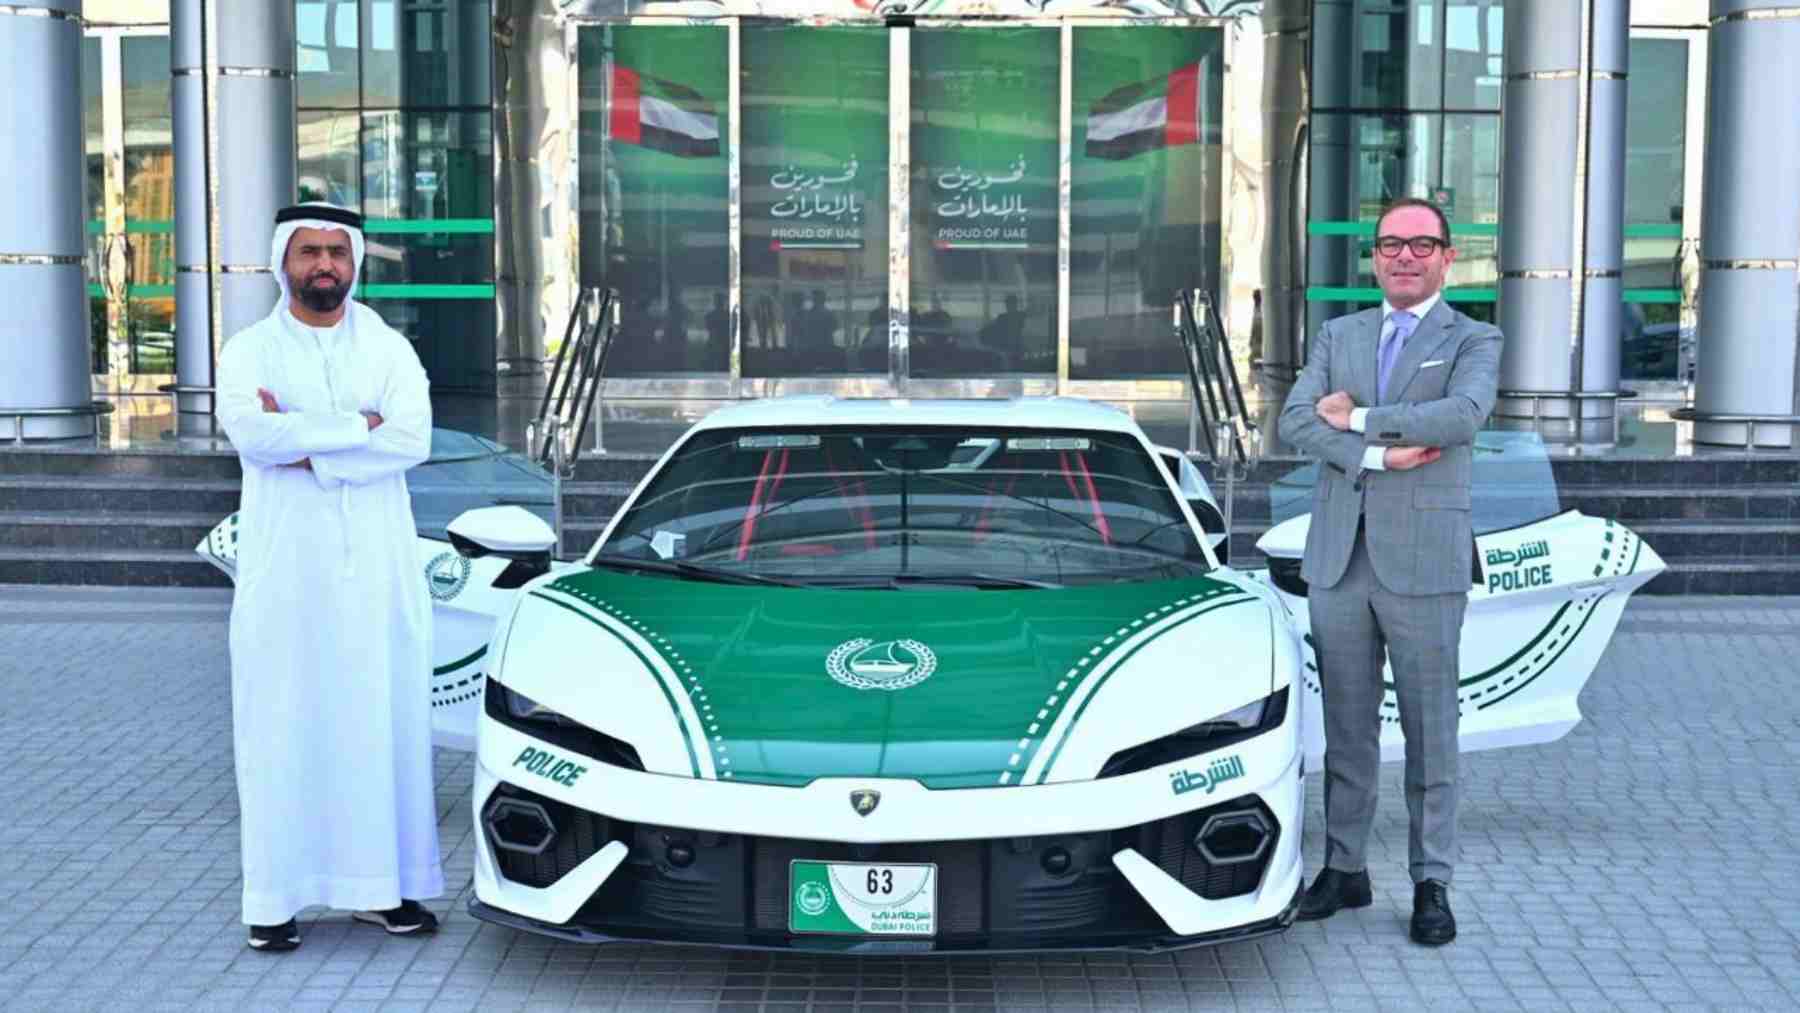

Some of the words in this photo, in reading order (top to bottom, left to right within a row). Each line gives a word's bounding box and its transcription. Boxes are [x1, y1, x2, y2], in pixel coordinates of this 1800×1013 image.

[770, 227, 815, 239] PROUD
[816, 227, 833, 239] OF
[835, 227, 861, 239] UAE
[938, 227, 981, 239] PROUD
[983, 227, 1000, 239] OF
[1002, 227, 1028, 239] UAE
[1486, 540, 1550, 567] الشرطة
[1488, 564, 1552, 594] POLICE
[512, 746, 588, 788] POLICE
[1169, 755, 1245, 795] الشرطة
[867, 869, 893, 894] 63
[871, 922, 897, 932] DUBAI
[900, 922, 930, 932] POLICE
